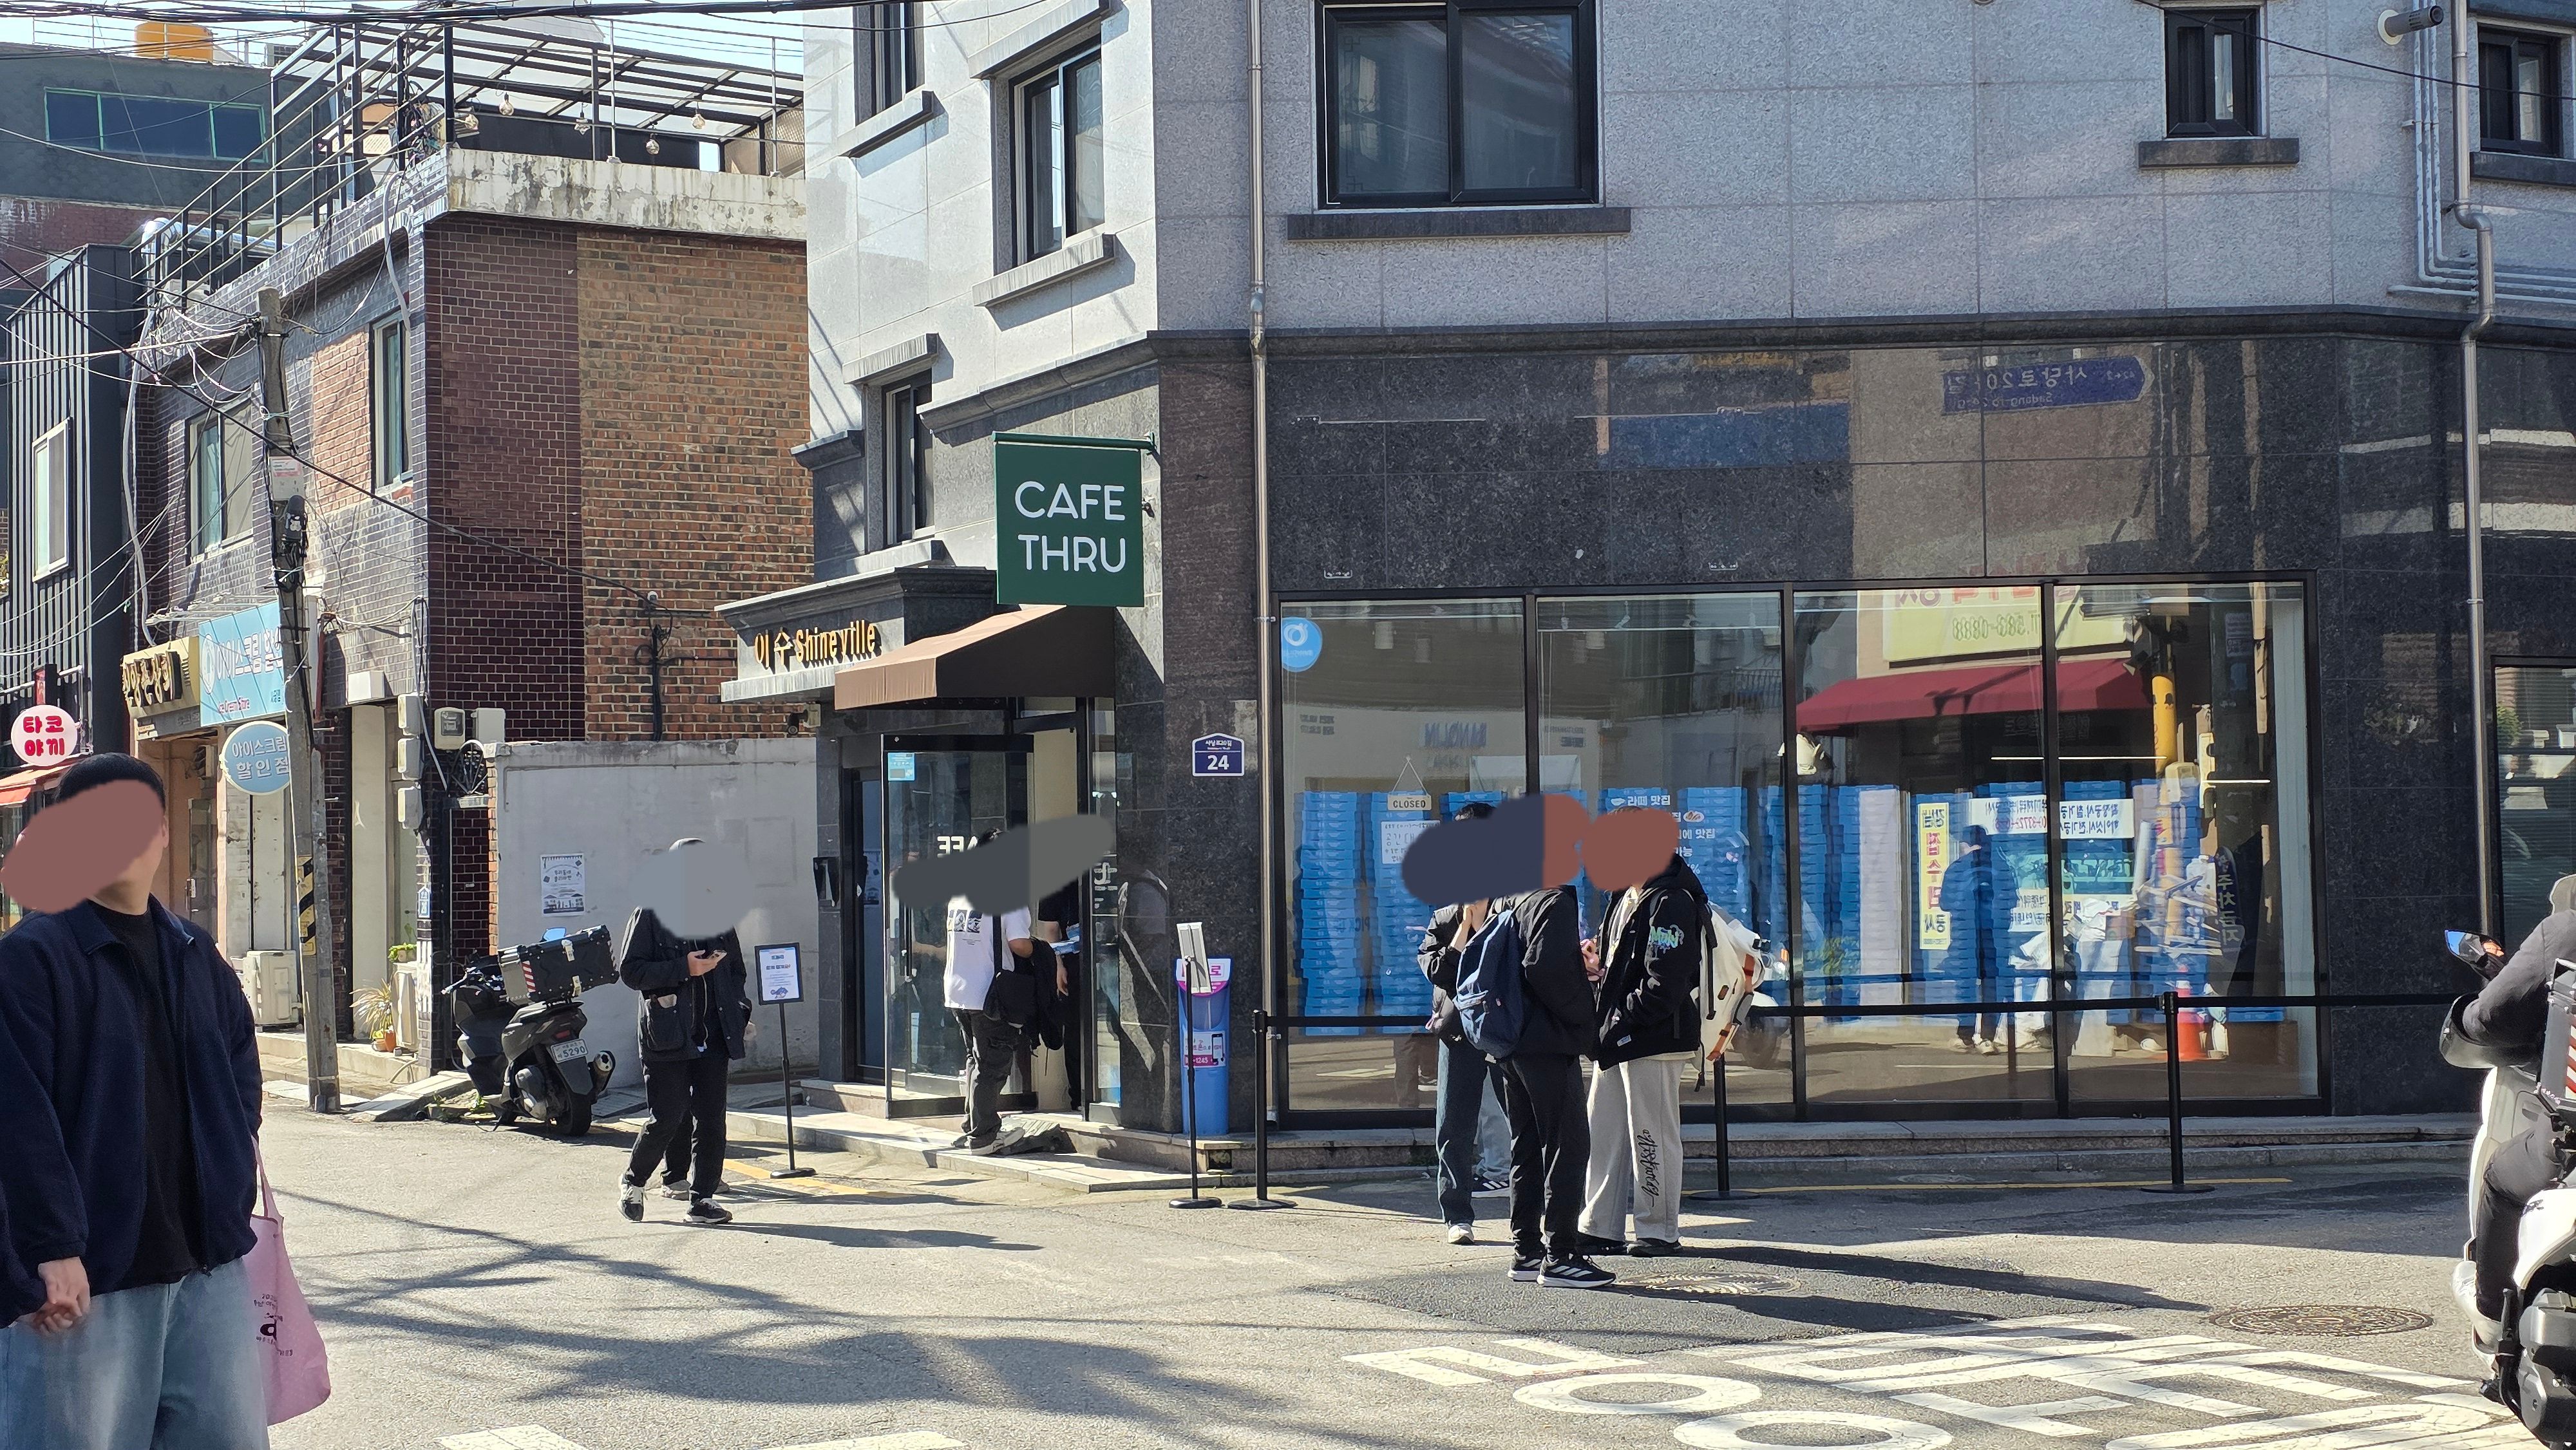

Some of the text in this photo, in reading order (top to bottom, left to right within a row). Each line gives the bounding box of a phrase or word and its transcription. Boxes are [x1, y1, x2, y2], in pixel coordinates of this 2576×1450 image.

[1015, 481, 1126, 520] CAFE
[1018, 534, 1126, 573] THRU
[216, 632, 261, 680] 아이스크림
[23, 715, 64, 733] 타코
[24, 738, 64, 757] 야끼
[232, 735, 287, 758] 아이스크림
[236, 756, 289, 780] 할인점
[1207, 755, 1229, 770] 24
[1392, 800, 1426, 808] CLOSED
[1651, 795, 1671, 805] 맛집
[1695, 829, 1716, 839] 맛집
[562, 1046, 585, 1057] 5290
